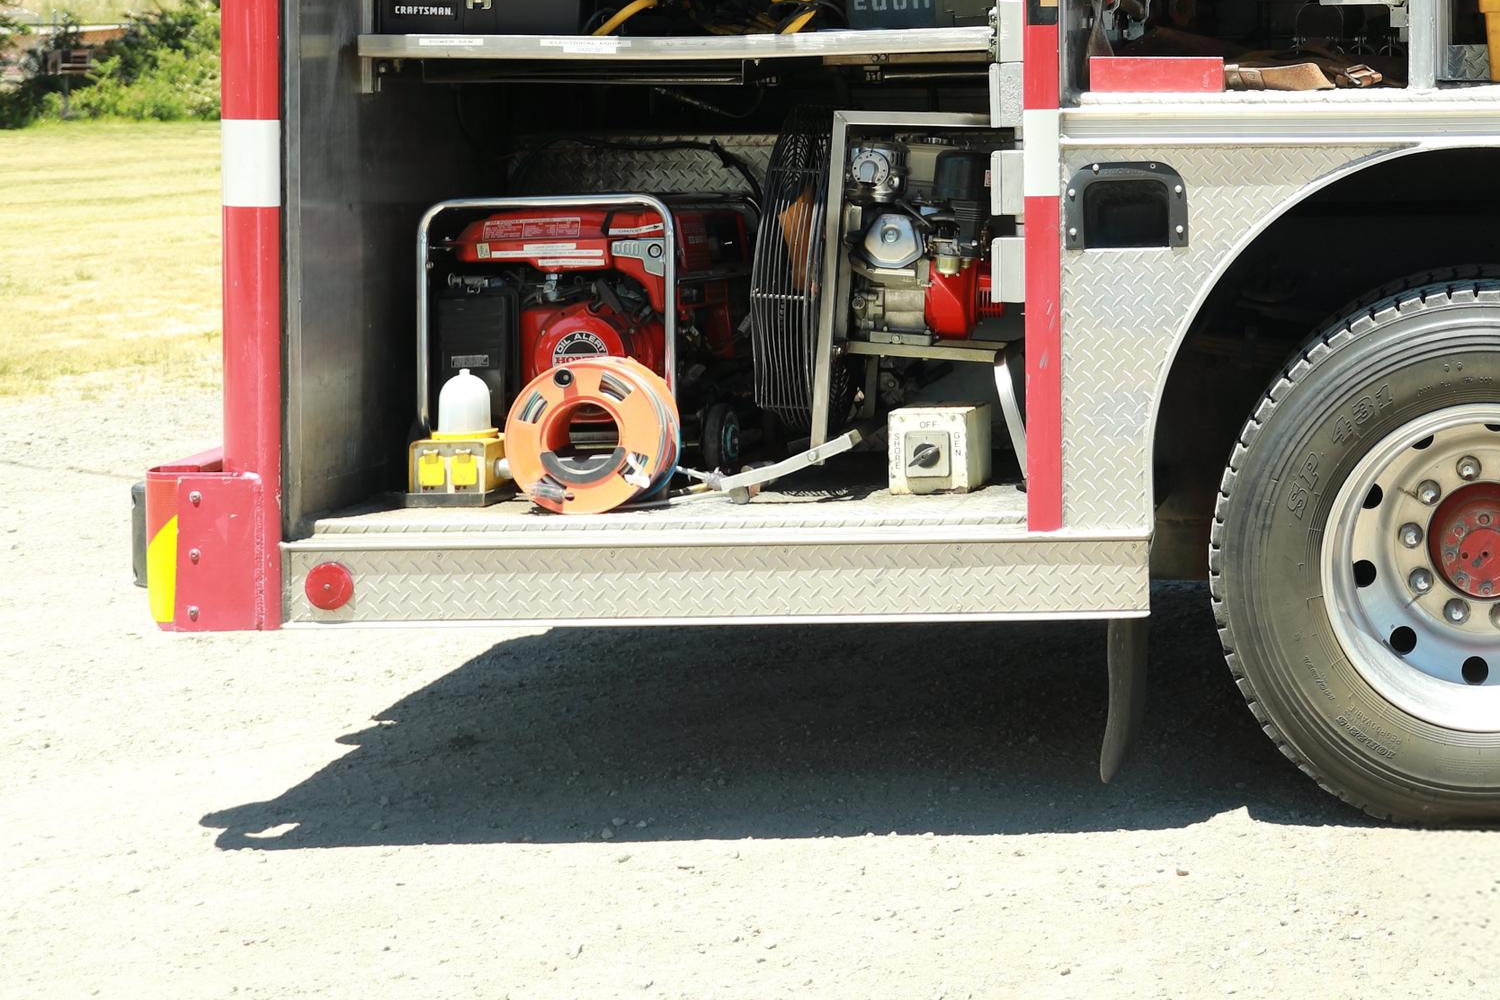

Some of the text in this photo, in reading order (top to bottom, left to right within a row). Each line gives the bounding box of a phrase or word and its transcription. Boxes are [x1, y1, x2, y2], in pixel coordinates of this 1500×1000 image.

[394, 5, 452, 16] CRAFTSMAN
[556, 333, 606, 353] OIL ALERT
[919, 420, 937, 429] OFF
[893, 432, 901, 470] SHORE
[953, 431, 962, 457] GEN
[1287, 383, 1393, 520] SP 431
